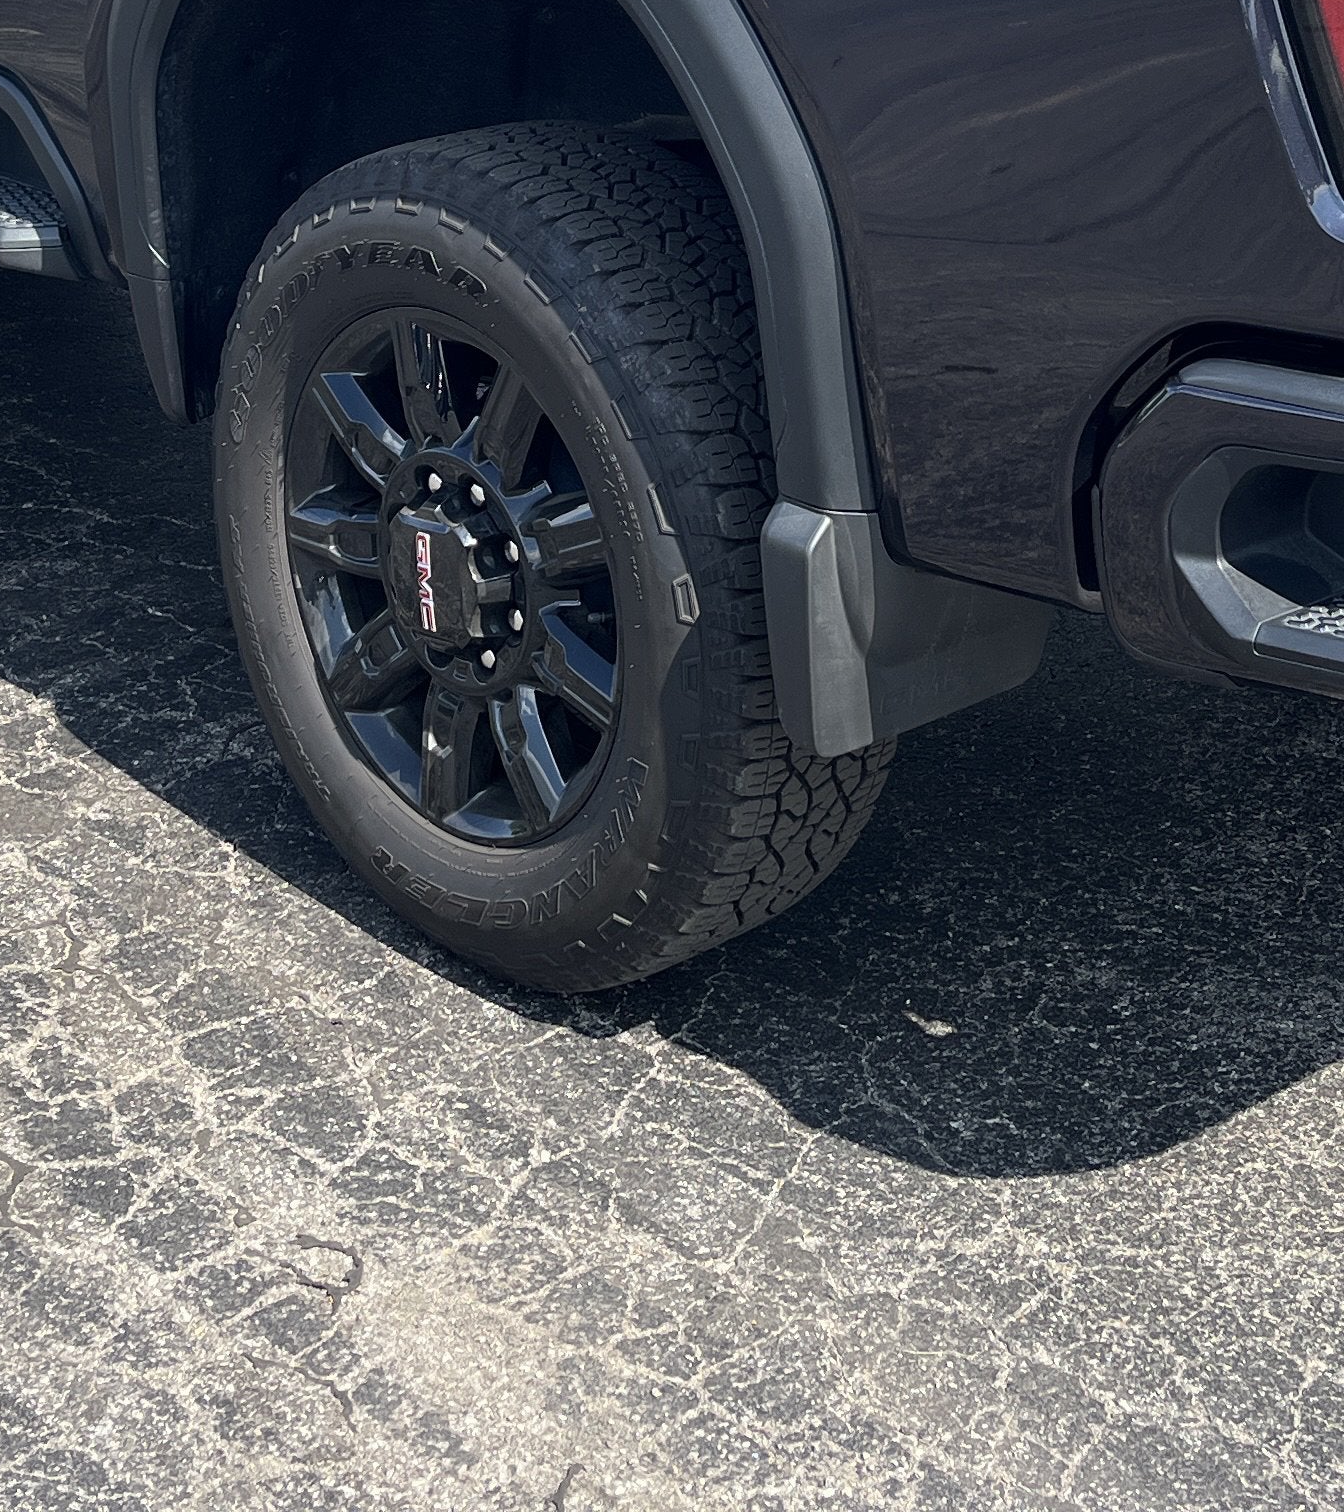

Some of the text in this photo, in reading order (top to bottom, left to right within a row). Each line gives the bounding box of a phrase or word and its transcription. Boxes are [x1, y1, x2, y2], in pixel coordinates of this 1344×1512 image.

[230, 239, 496, 443] GOODYEAR
[415, 531, 437, 634] GMC
[373, 756, 651, 929] WRANGLER
